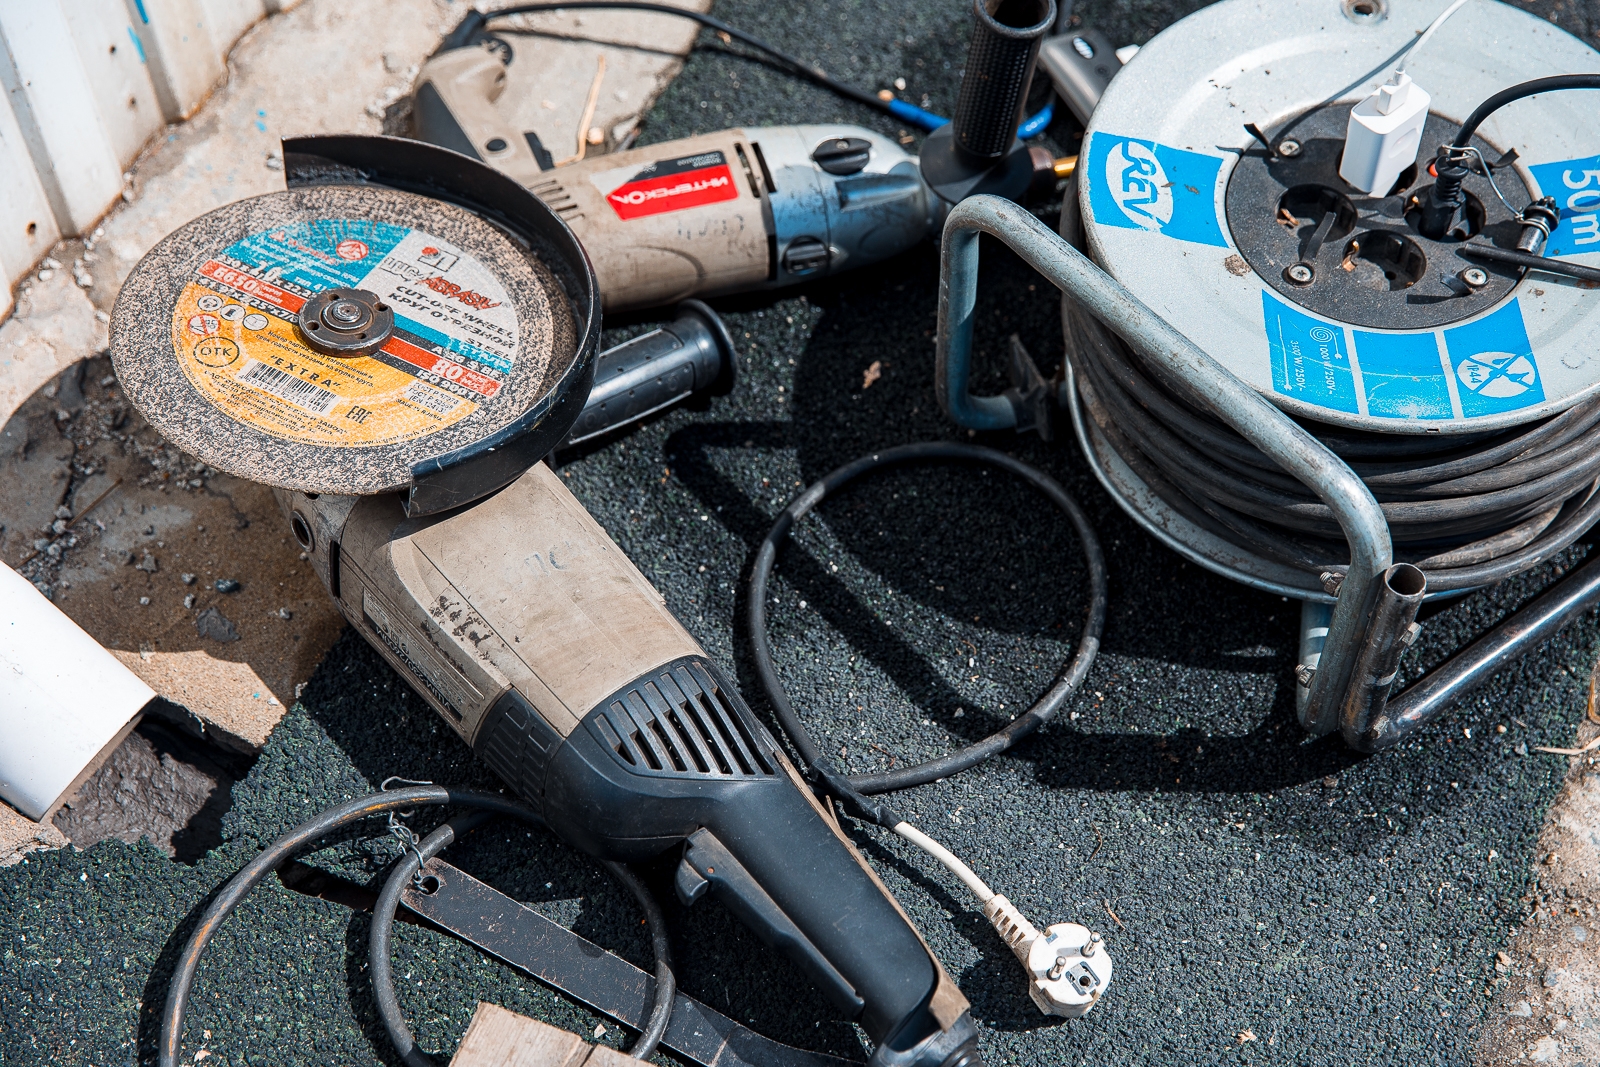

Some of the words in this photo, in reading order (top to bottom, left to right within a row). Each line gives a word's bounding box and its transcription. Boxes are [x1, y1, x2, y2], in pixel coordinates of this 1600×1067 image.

[611, 175, 729, 205] ИНТЕРСКОЛ
[1562, 169, 1600, 246] 50m
[210, 266, 257, 291] 6650
[387, 292, 429, 312] КРУГ
[429, 308, 515, 348] ОТРЕЗНОЙ
[395, 285, 460, 315] CUT-OFF
[460, 312, 516, 338] WHEEL
[266, 331, 288, 342] Номер
[463, 336, 512, 360] STEEL
[199, 339, 235, 363] ОТК
[254, 334, 270, 343] срок
[270, 340, 298, 354] годности
[298, 352, 325, 365] указаны
[333, 367, 355, 379] втулке
[431, 345, 446, 354] A
[415, 370, 441, 384] ISO
[429, 358, 465, 381] 80
[245, 377, 280, 394] 603347
[282, 393, 319, 411] 221310
